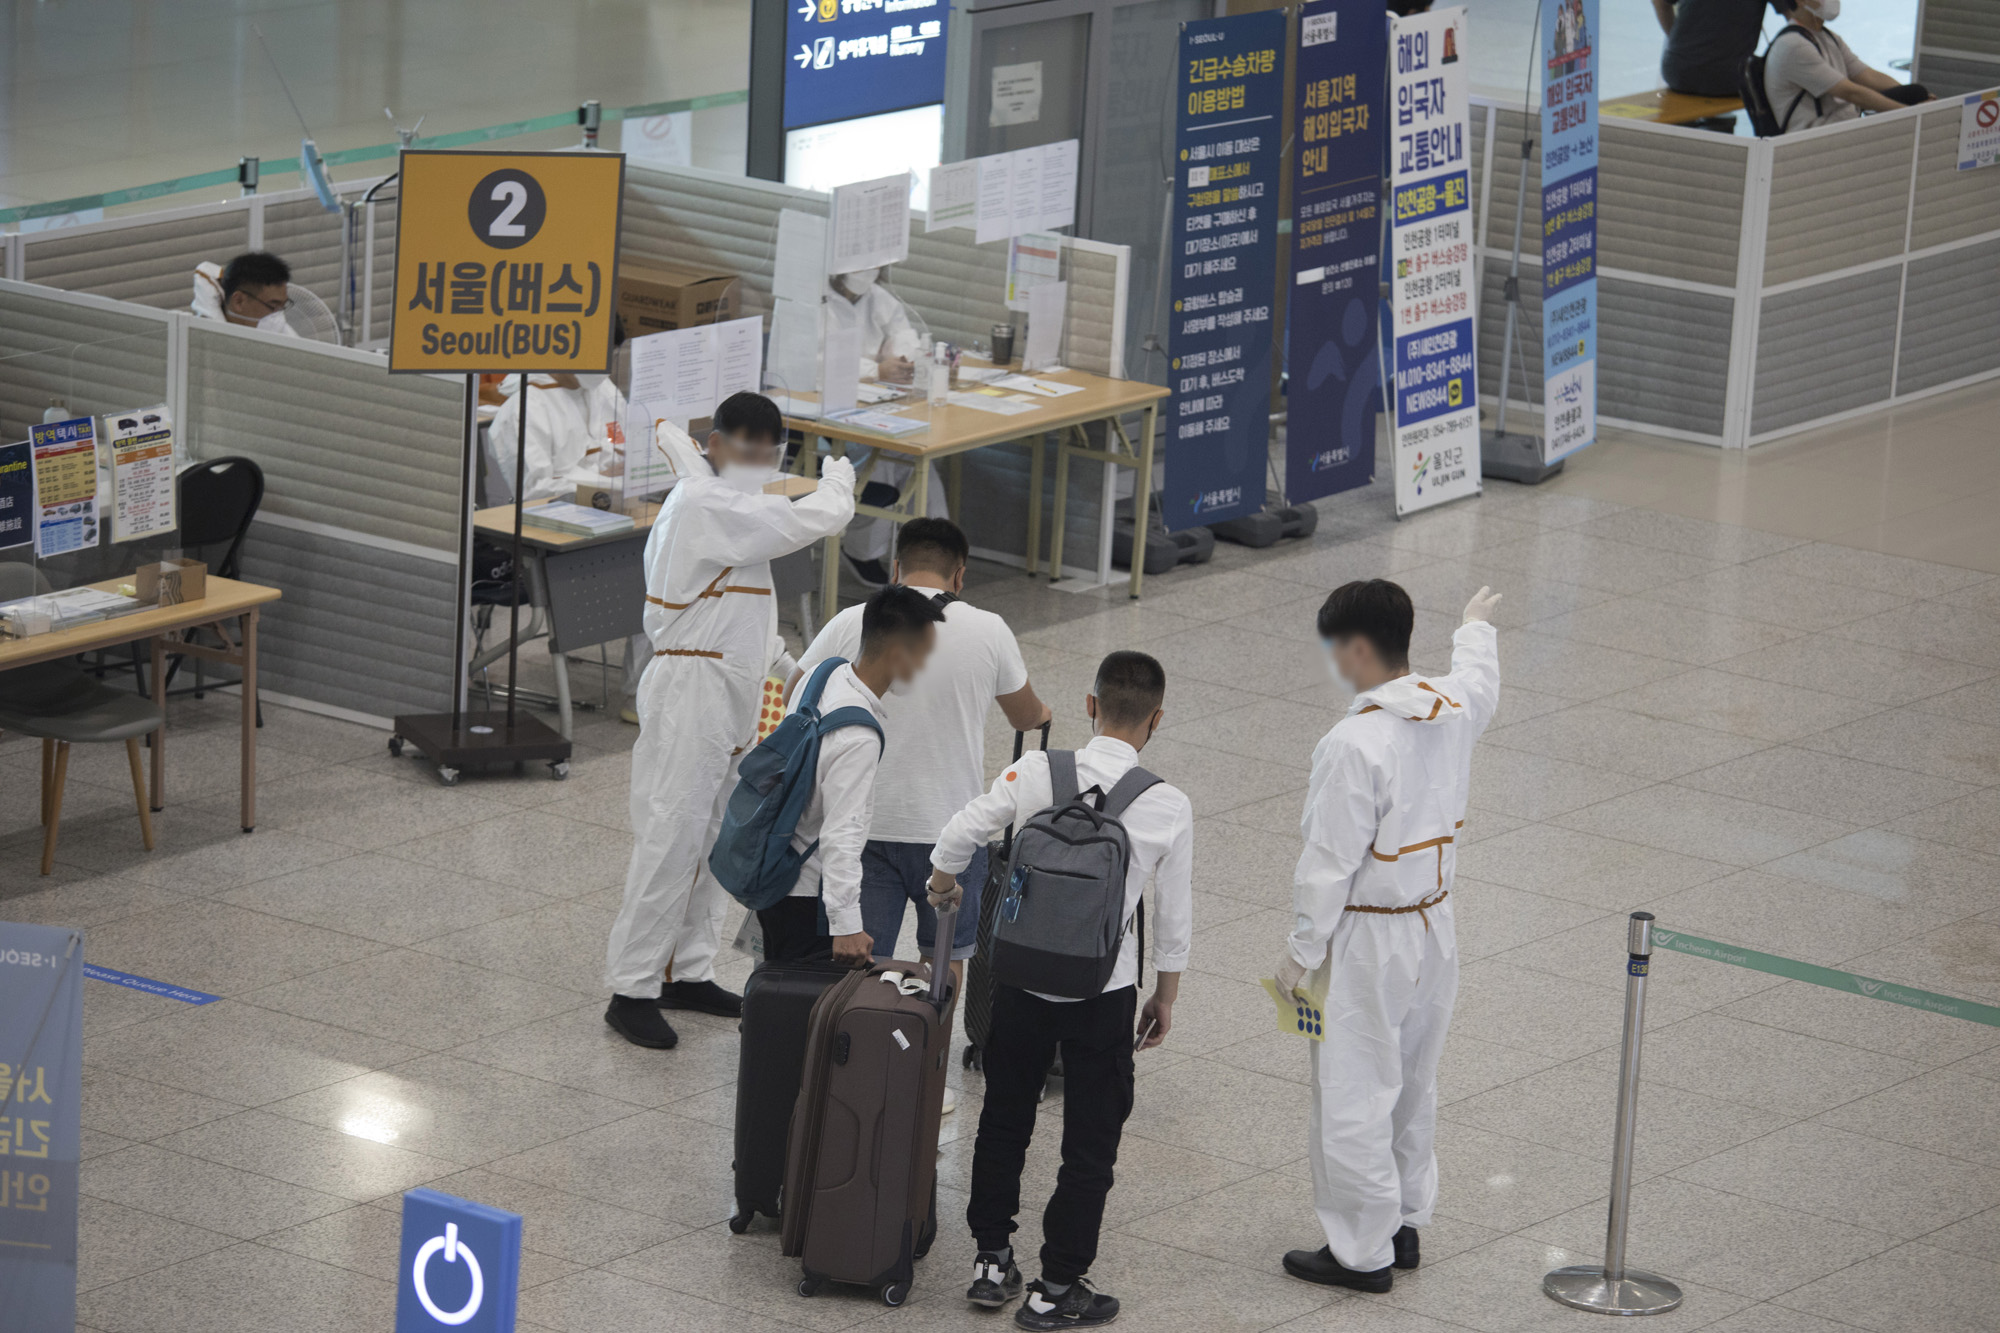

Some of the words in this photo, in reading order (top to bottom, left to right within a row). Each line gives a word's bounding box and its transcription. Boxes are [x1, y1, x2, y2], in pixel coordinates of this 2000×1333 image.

[1190, 49, 1275, 83] 긴급수송차량
[1397, 30, 1428, 74] 해외
[1188, 85, 1245, 115] 이용방법
[1304, 73, 1356, 109] 서울지역
[1398, 77, 1446, 126] 입국자
[1546, 80, 1564, 109] 해외
[1565, 71, 1593, 100] 입국자
[1303, 104, 1369, 142] 해외입국자
[1552, 100, 1587, 135] 교통안내
[1190, 144, 1215, 160] 서울시
[1235, 137, 1260, 154] 대상은
[1302, 145, 1328, 177] 안내
[1398, 122, 1462, 175] 교통안내
[1545, 144, 1570, 170] 인천공항
[488, 180, 528, 237] 2
[1397, 184, 1436, 220] 인천공항
[1444, 177, 1465, 208] 울진
[1403, 227, 1432, 251] 인천공항
[1434, 219, 1459, 242] 1터미널
[1184, 261, 1202, 278] 대기
[1203, 256, 1237, 275] 해주세요
[1416, 252, 1429, 273] 출구
[1431, 242, 1468, 267] 버스승강장
[408, 260, 601, 317] 서울(버스)
[1404, 276, 1433, 300] 인천공항
[1435, 268, 1461, 291] 2터미널
[1243, 306, 1269, 323] 주세요
[1401, 306, 1412, 325] 1번
[1414, 302, 1428, 322] 출구
[1431, 291, 1467, 315] 버스승강장
[421, 320, 581, 359] Seoul(BUS)
[1181, 352, 1207, 370] 지정된
[1207, 345, 1241, 365] 장소에서
[1398, 352, 1472, 390] M.010-8341-8844
[1180, 377, 1197, 393] 대기
[1406, 385, 1448, 414] NEW8844
[1179, 398, 1204, 416] 안내에
[1205, 416, 1230, 433] 주세요
[0, 461, 27, 474] rantine
[1433, 446, 1463, 471] 울진군
[1451, 469, 1466, 482] GUN
[1675, 940, 1711, 956] Incheon
[1714, 949, 1747, 964] Airport
[122, 978, 167, 992] Queue
[168, 990, 202, 1001] Here
[1884, 989, 1922, 1005] Incheon
[1925, 1000, 1958, 1014] Airport
